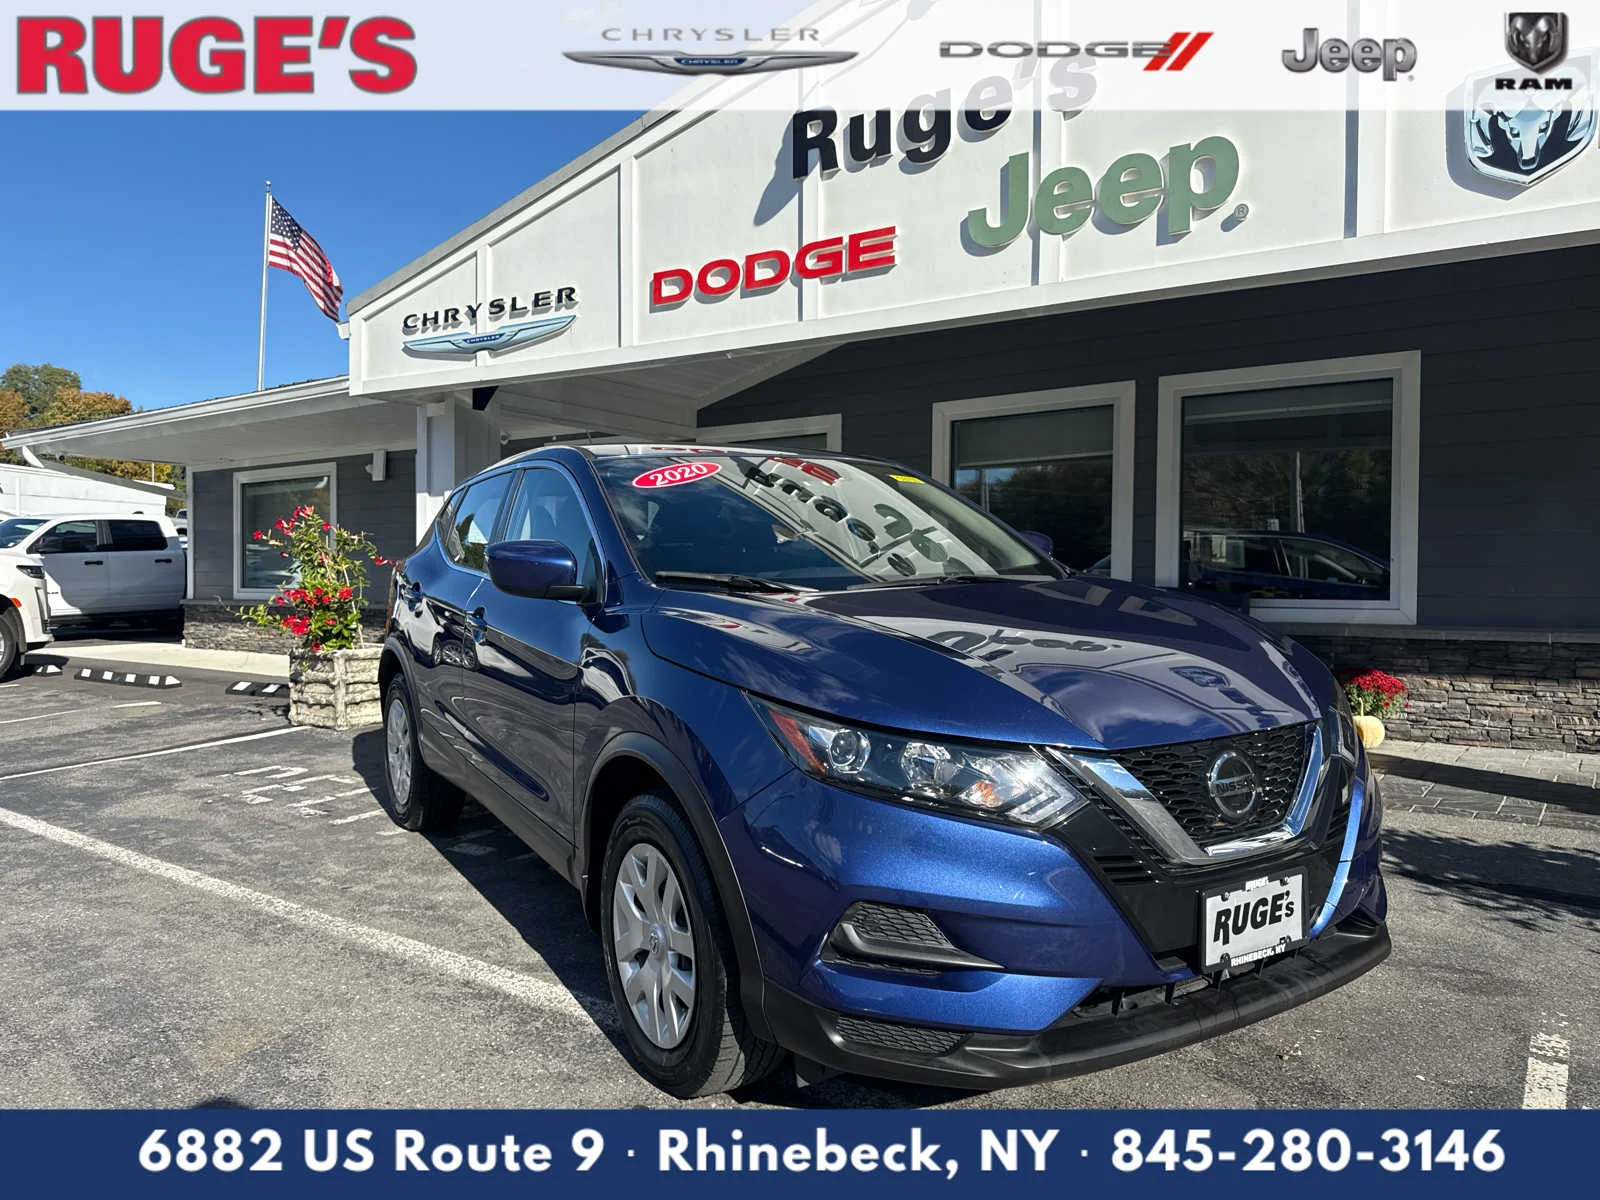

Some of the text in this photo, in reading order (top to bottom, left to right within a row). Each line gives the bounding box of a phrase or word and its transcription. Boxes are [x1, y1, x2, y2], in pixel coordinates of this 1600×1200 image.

[967, 135, 1240, 247] Jeep
[653, 226, 896, 305] DODGE
[403, 286, 576, 330] CHRYSLER
[649, 463, 709, 487] 2020
[1275, 943, 1287, 955] NY
